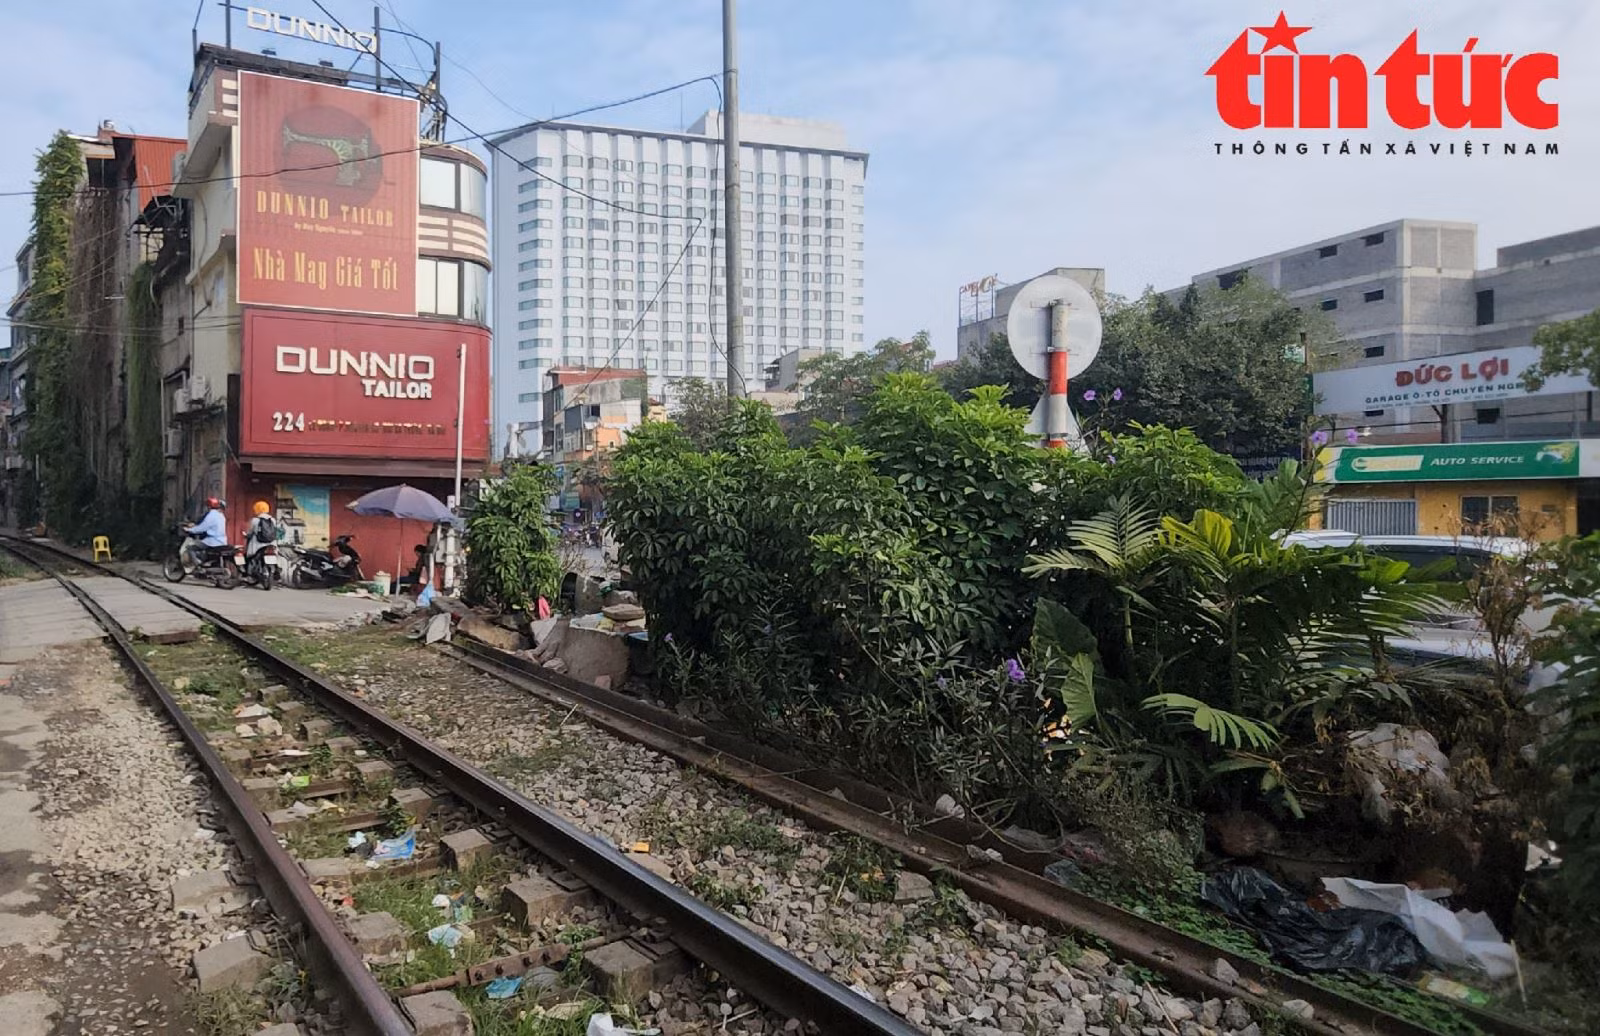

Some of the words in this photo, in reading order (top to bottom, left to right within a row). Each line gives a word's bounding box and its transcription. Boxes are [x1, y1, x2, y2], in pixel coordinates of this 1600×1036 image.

[247, 6, 377, 54] DUNNIO
[256, 190, 329, 220] DUNNIO
[340, 204, 393, 227] TAILOR
[253, 247, 285, 281] Nhà
[294, 251, 327, 290] May
[335, 255, 363, 288] Giá
[371, 257, 398, 290] Tốt
[276, 344, 435, 380] DUNNIO
[1394, 363, 1453, 388] ĐỨC
[1461, 357, 1510, 382] LỢI
[361, 379, 432, 399] TAILOR
[1365, 393, 1409, 404] GARAGE
[272, 411, 305, 432] 224
[1429, 457, 1466, 466] AUTO
[1470, 456, 1524, 465] SERVICE
